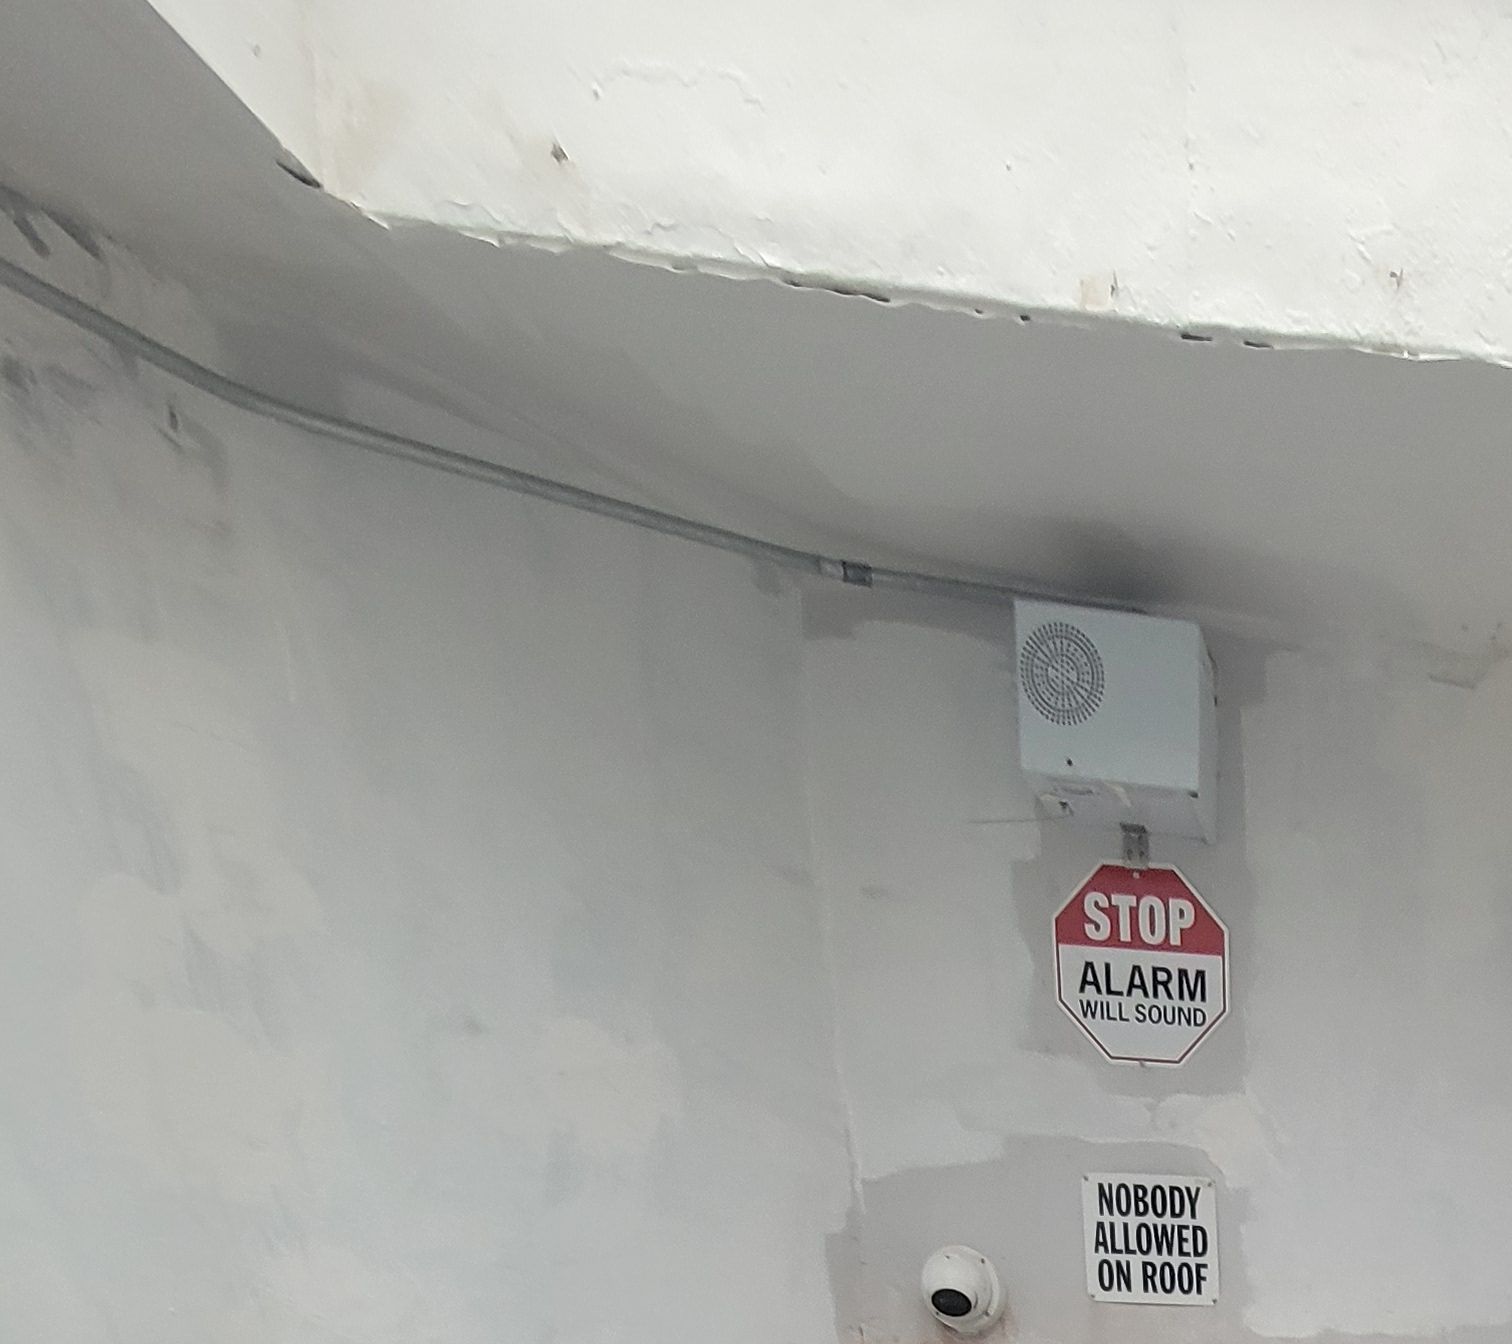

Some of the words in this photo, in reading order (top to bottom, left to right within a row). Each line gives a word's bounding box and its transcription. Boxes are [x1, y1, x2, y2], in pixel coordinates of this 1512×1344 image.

[1083, 891, 1196, 946] STOP
[1078, 961, 1207, 1003] ALARM
[1079, 999, 1130, 1022] WILL
[1135, 1004, 1207, 1027] SOUND
[1097, 1182, 1201, 1220] NOBODY
[1094, 1221, 1208, 1258] ALLOWED
[1098, 1258, 1132, 1293] ON
[1141, 1260, 1208, 1295] ROOF
